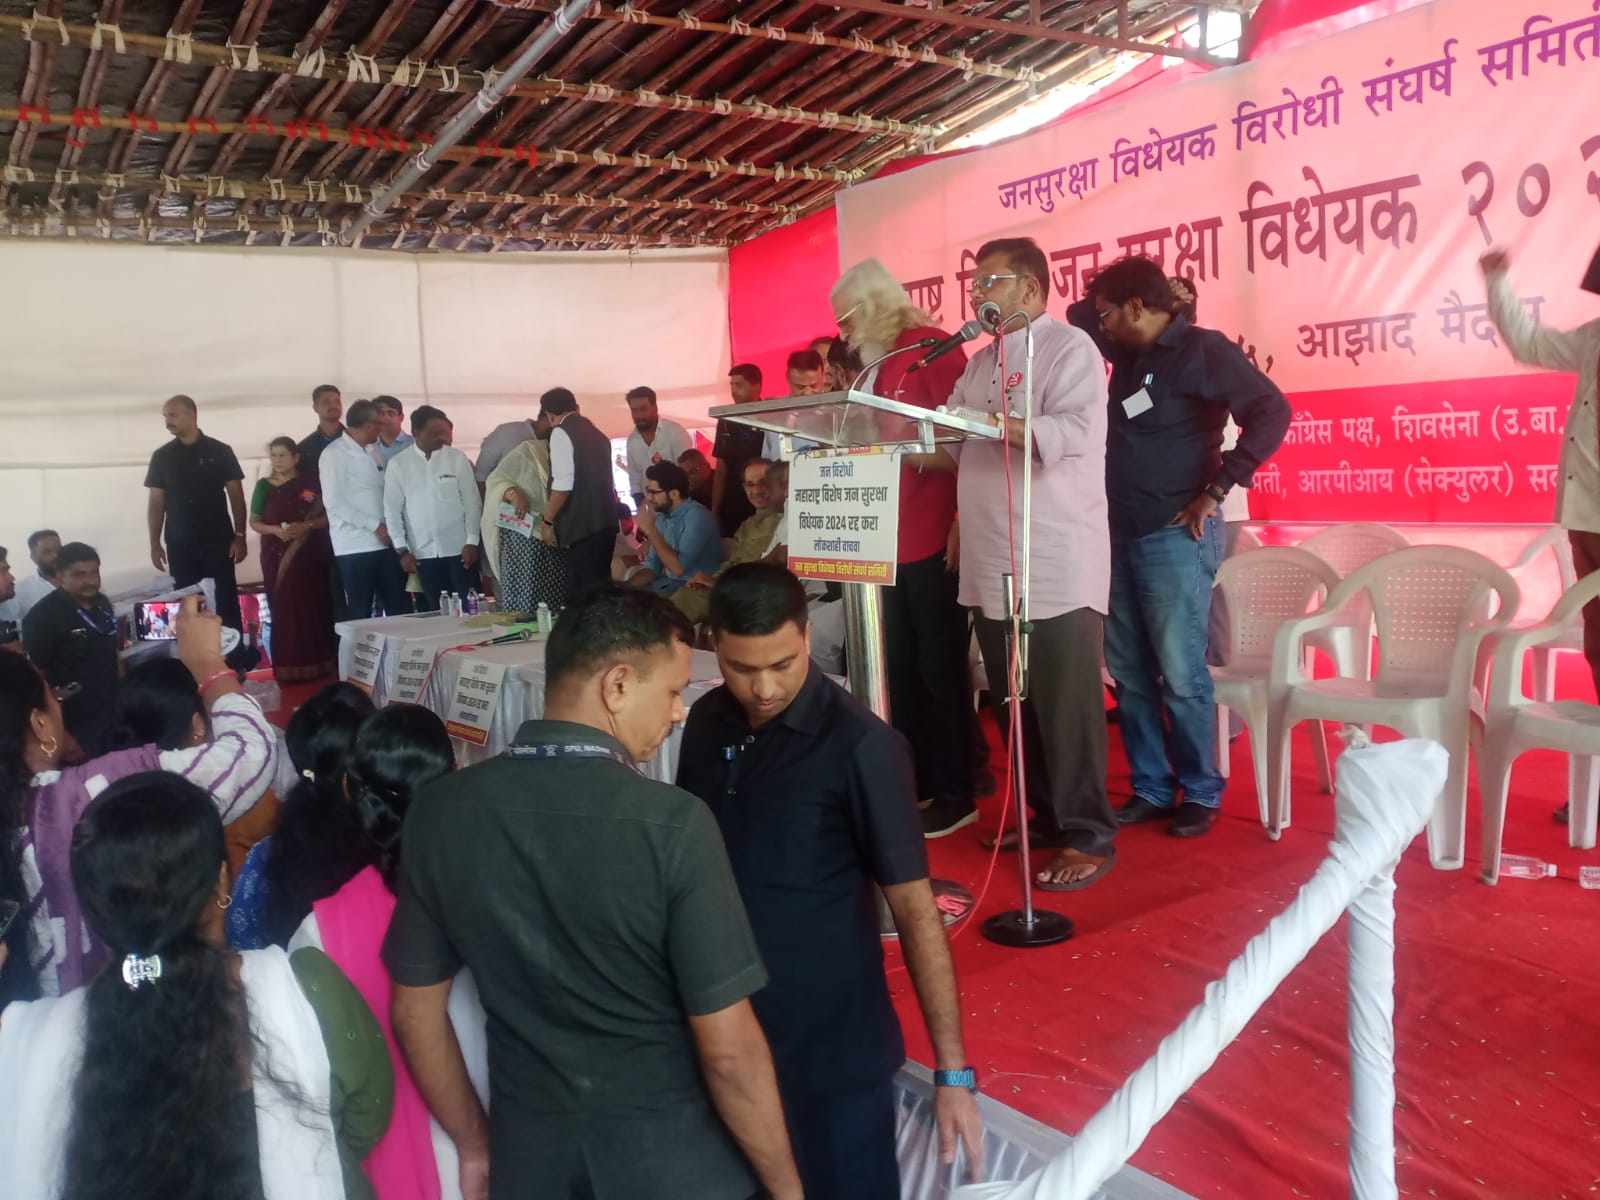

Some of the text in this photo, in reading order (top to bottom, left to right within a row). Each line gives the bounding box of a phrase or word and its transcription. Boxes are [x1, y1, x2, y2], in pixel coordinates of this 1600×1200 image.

[998, 158, 1100, 213] जनसुरक्षा
[1109, 123, 1217, 183] विधेयक
[1231, 75, 1344, 150] विरोधी
[1361, 38, 1459, 117] संघर्ष
[1238, 165, 1422, 275] विधेयक
[1296, 312, 1417, 367] आझाद
[1341, 416, 1381, 447] पक्ष,
[1391, 401, 1480, 442] शिवसेना
[820, 461, 854, 479] जन विरोधी
[1299, 460, 1394, 494] आरपीआय
[1404, 456, 1514, 502] (सेक्युलर)
[821, 484, 843, 503] विशेष
[844, 487, 859, 503] जन
[861, 486, 888, 506] सुरक्षा
[799, 512, 879, 532] विधेयक 2024 रद्द करा
